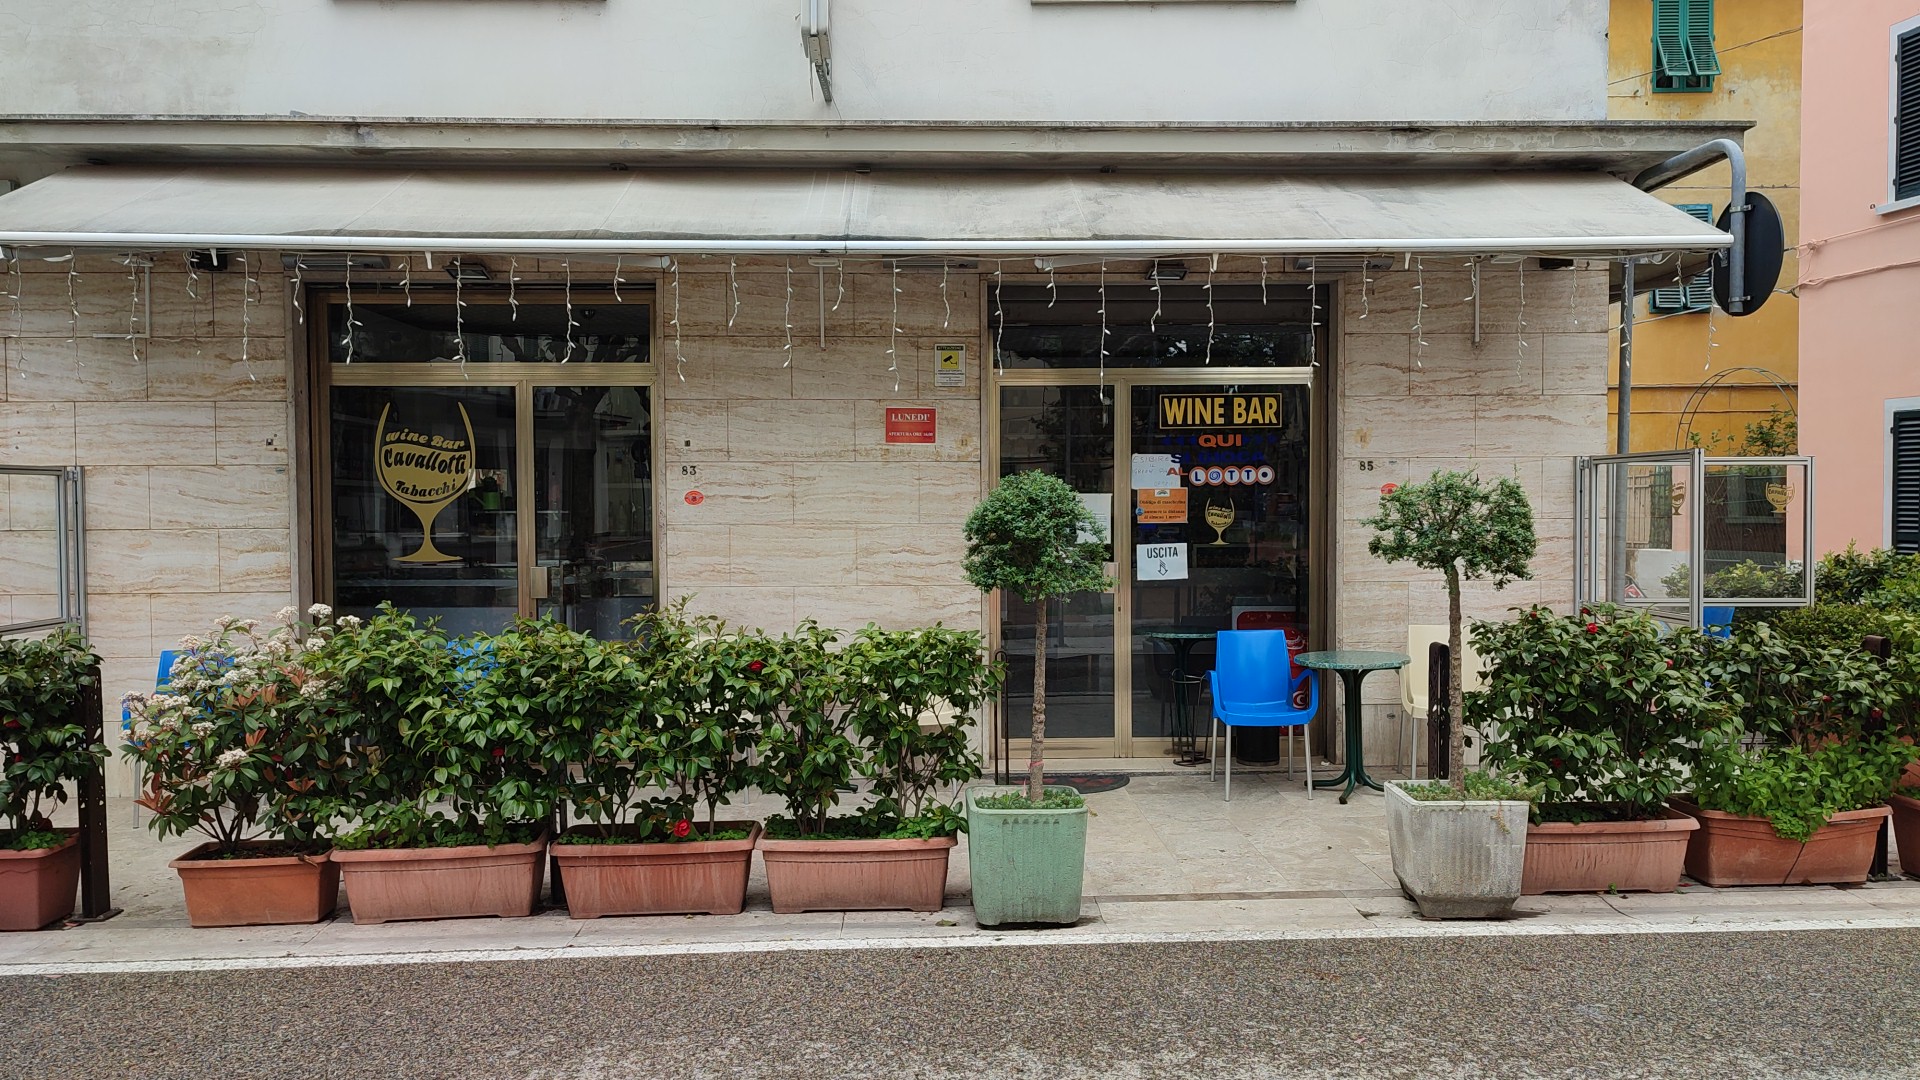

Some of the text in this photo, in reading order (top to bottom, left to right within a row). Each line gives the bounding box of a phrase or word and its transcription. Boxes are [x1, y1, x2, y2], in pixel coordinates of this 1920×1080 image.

[1164, 397, 1278, 425] WINE BAR
[431, 435, 465, 449] Bar
[1198, 433, 1242, 448] QUI
[384, 448, 467, 475] Cavallotti
[1359, 460, 1374, 471] 85
[681, 465, 697, 476] 83
[1166, 467, 1188, 476] AL
[1189, 466, 1274, 485] LOTTO
[395, 478, 457, 497] Tabacchi
[1146, 546, 1178, 559] USCITA
